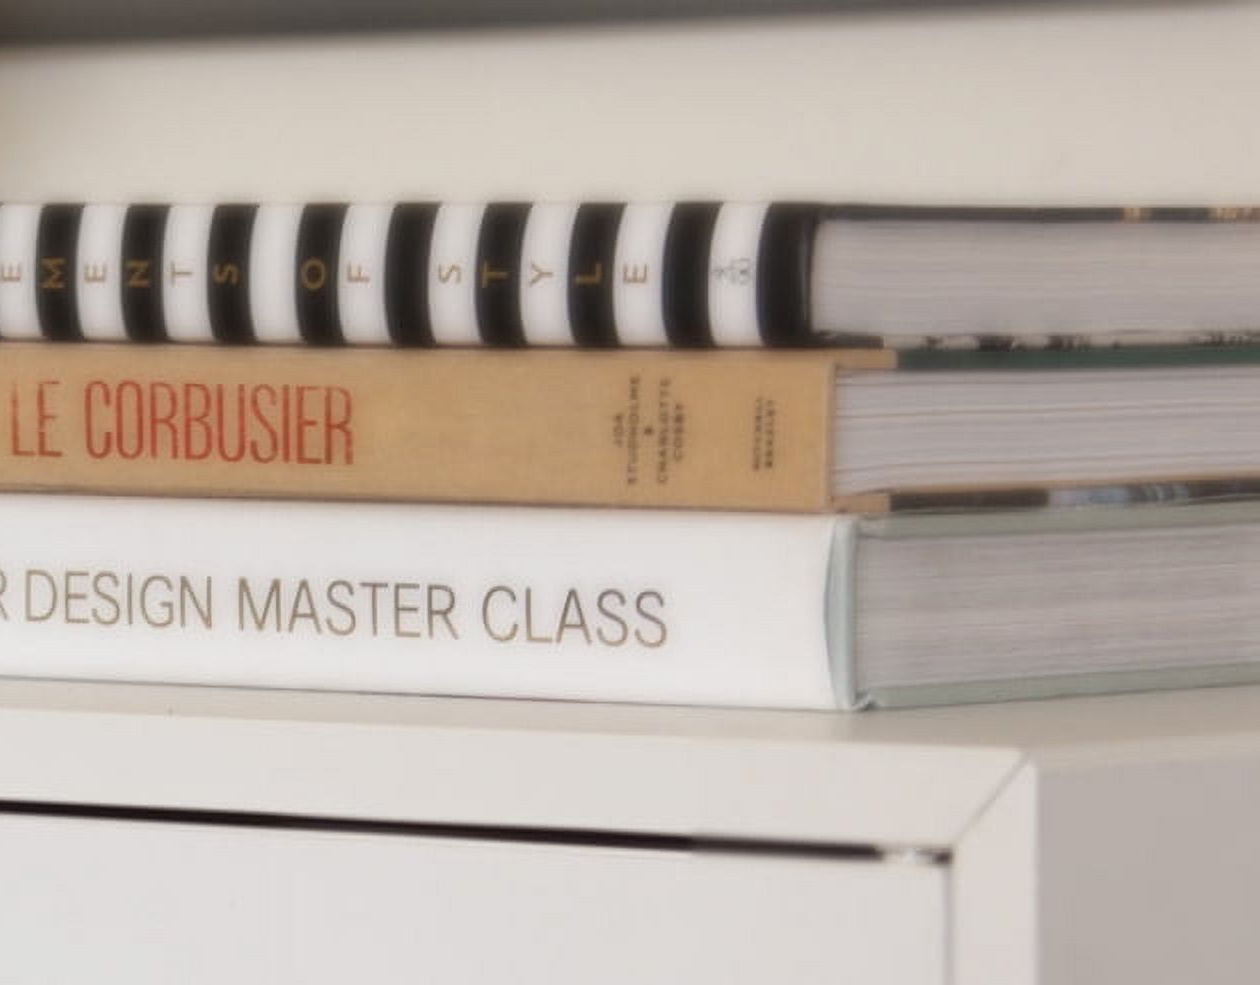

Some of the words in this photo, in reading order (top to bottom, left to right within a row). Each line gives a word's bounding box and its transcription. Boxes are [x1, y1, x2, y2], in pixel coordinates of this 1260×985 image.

[301, 258, 372, 289] OF
[439, 260, 651, 288] STYLE
[11, 380, 65, 458] LE
[84, 380, 355, 466] CORBUSIER
[24, 567, 213, 630] DESIGN
[238, 576, 460, 640] MASTER
[482, 584, 669, 648] CLASS
